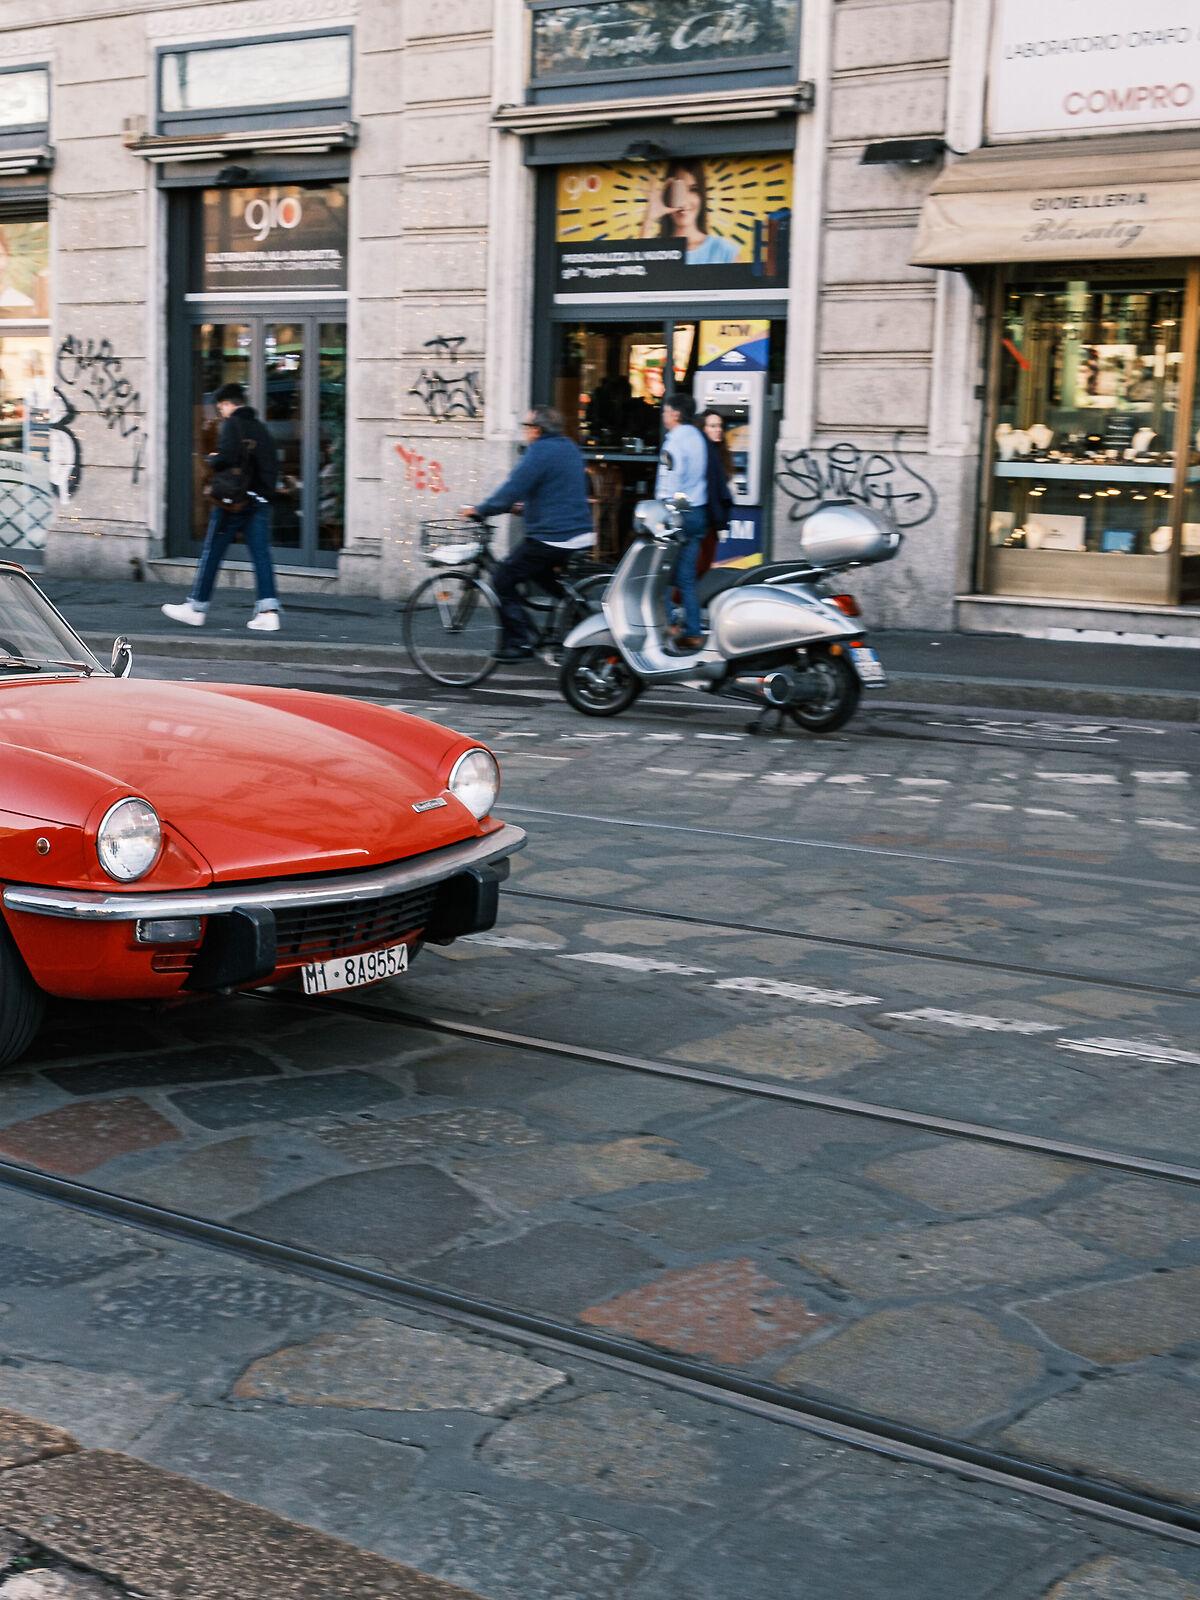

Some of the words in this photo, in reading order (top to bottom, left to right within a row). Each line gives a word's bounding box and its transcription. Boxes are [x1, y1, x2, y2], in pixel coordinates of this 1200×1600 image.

[1003, 34, 1121, 60] LABORATORIO
[1127, 27, 1189, 48] ORAFO
[1063, 83, 1194, 115] COMPRO
[244, 188, 302, 241] glo
[1030, 193, 1147, 211] GIOIELLERIA
[718, 324, 751, 337] ATM
[715, 381, 743, 392] ATM
